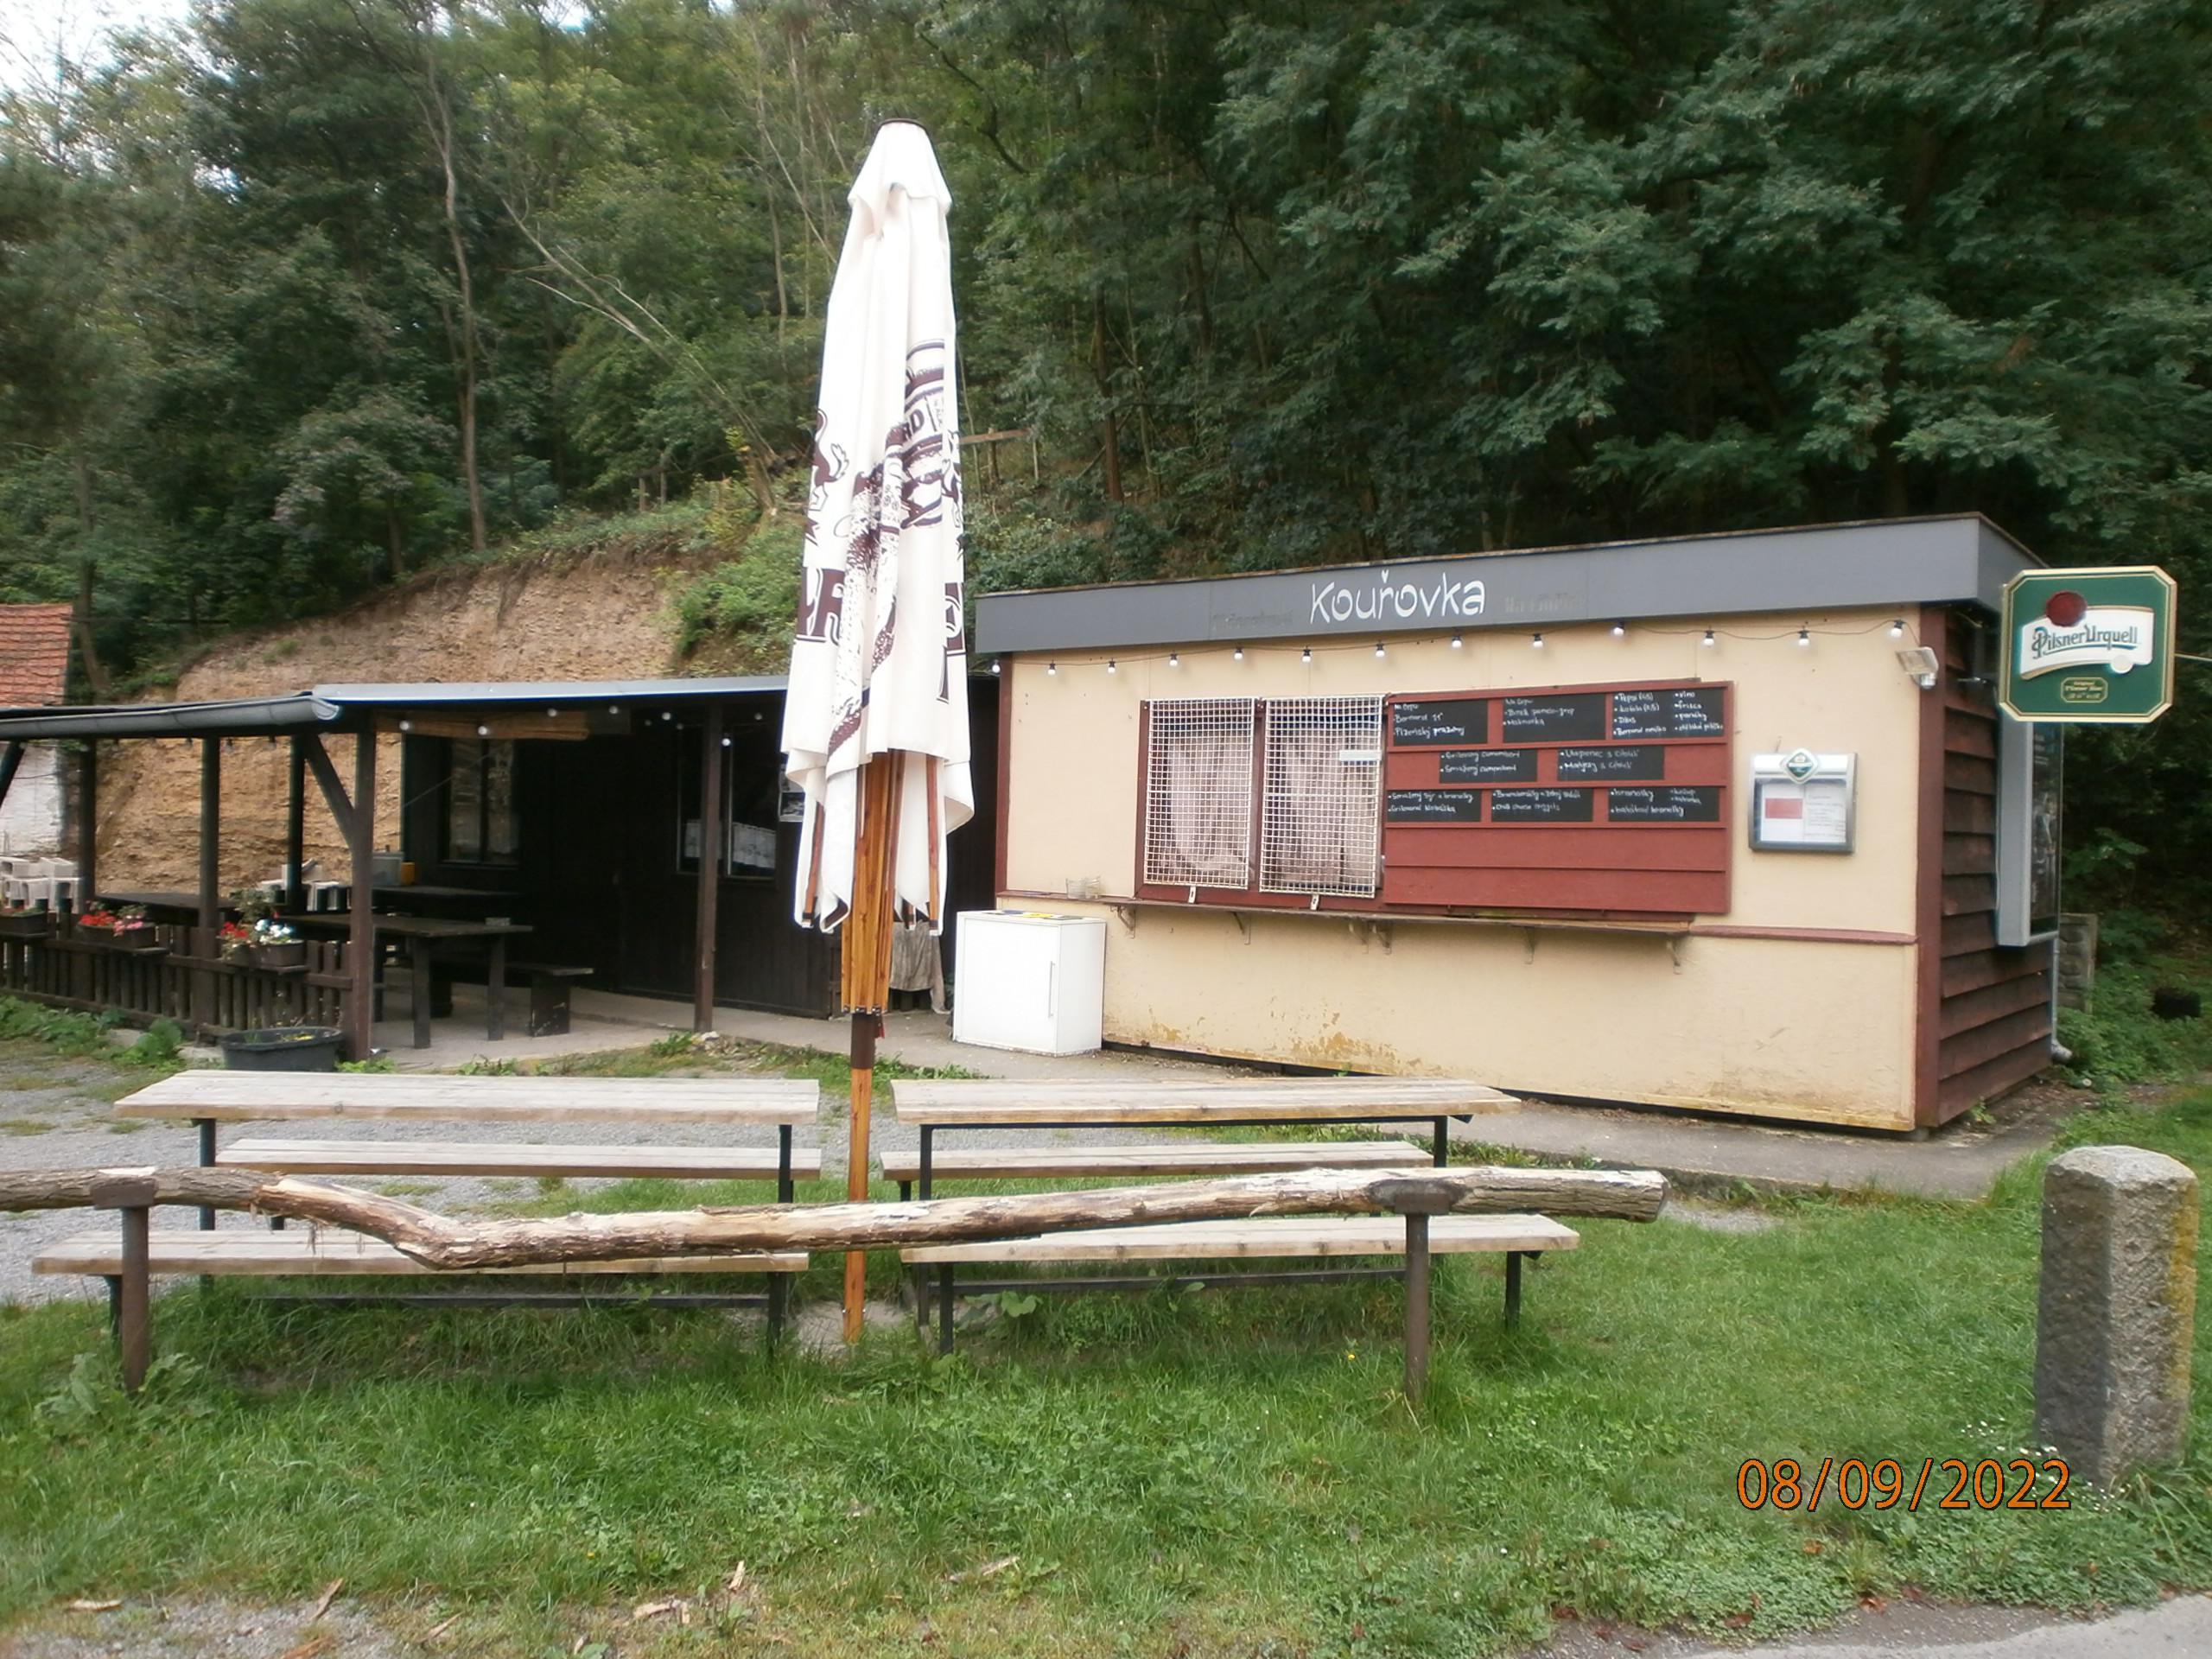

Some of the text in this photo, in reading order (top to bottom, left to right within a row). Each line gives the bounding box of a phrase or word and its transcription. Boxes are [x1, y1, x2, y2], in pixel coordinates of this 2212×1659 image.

[1309, 569, 1485, 625] Kouřovka
[2031, 625, 2138, 659] Pilsner Urquell
